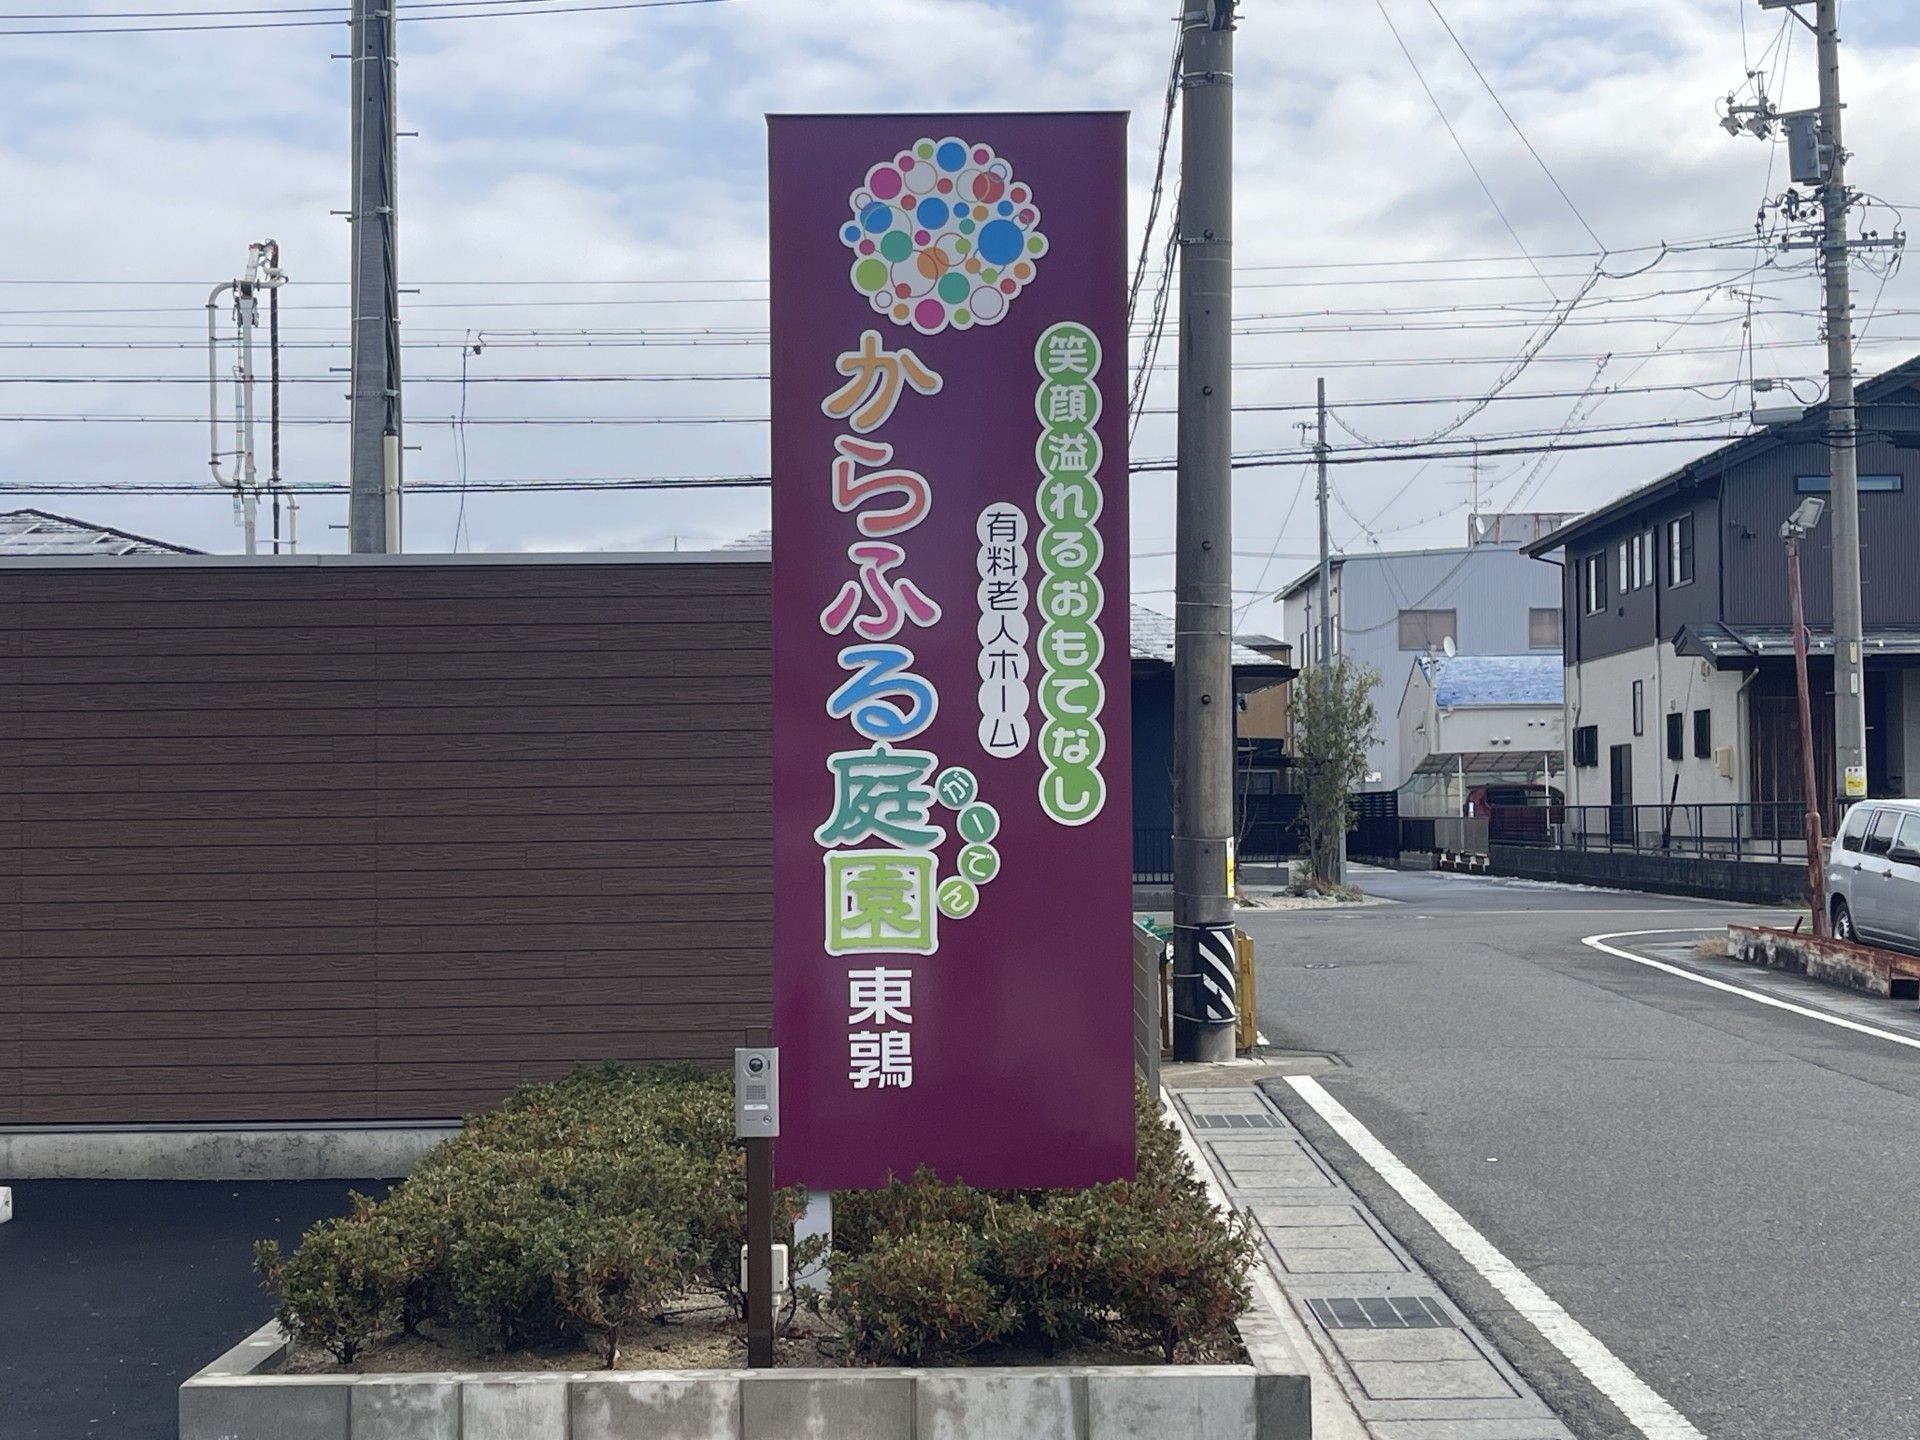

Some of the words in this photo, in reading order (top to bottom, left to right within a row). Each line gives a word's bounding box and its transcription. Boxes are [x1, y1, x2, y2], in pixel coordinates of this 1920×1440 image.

[819, 335, 940, 952] からふる庭園
[985, 511, 1020, 751] 有料老人ホーム
[1047, 335, 1091, 812] 笑顔溢れるおもてなし
[941, 770, 994, 913] がーでん
[848, 966, 913, 1089] 東鶉
